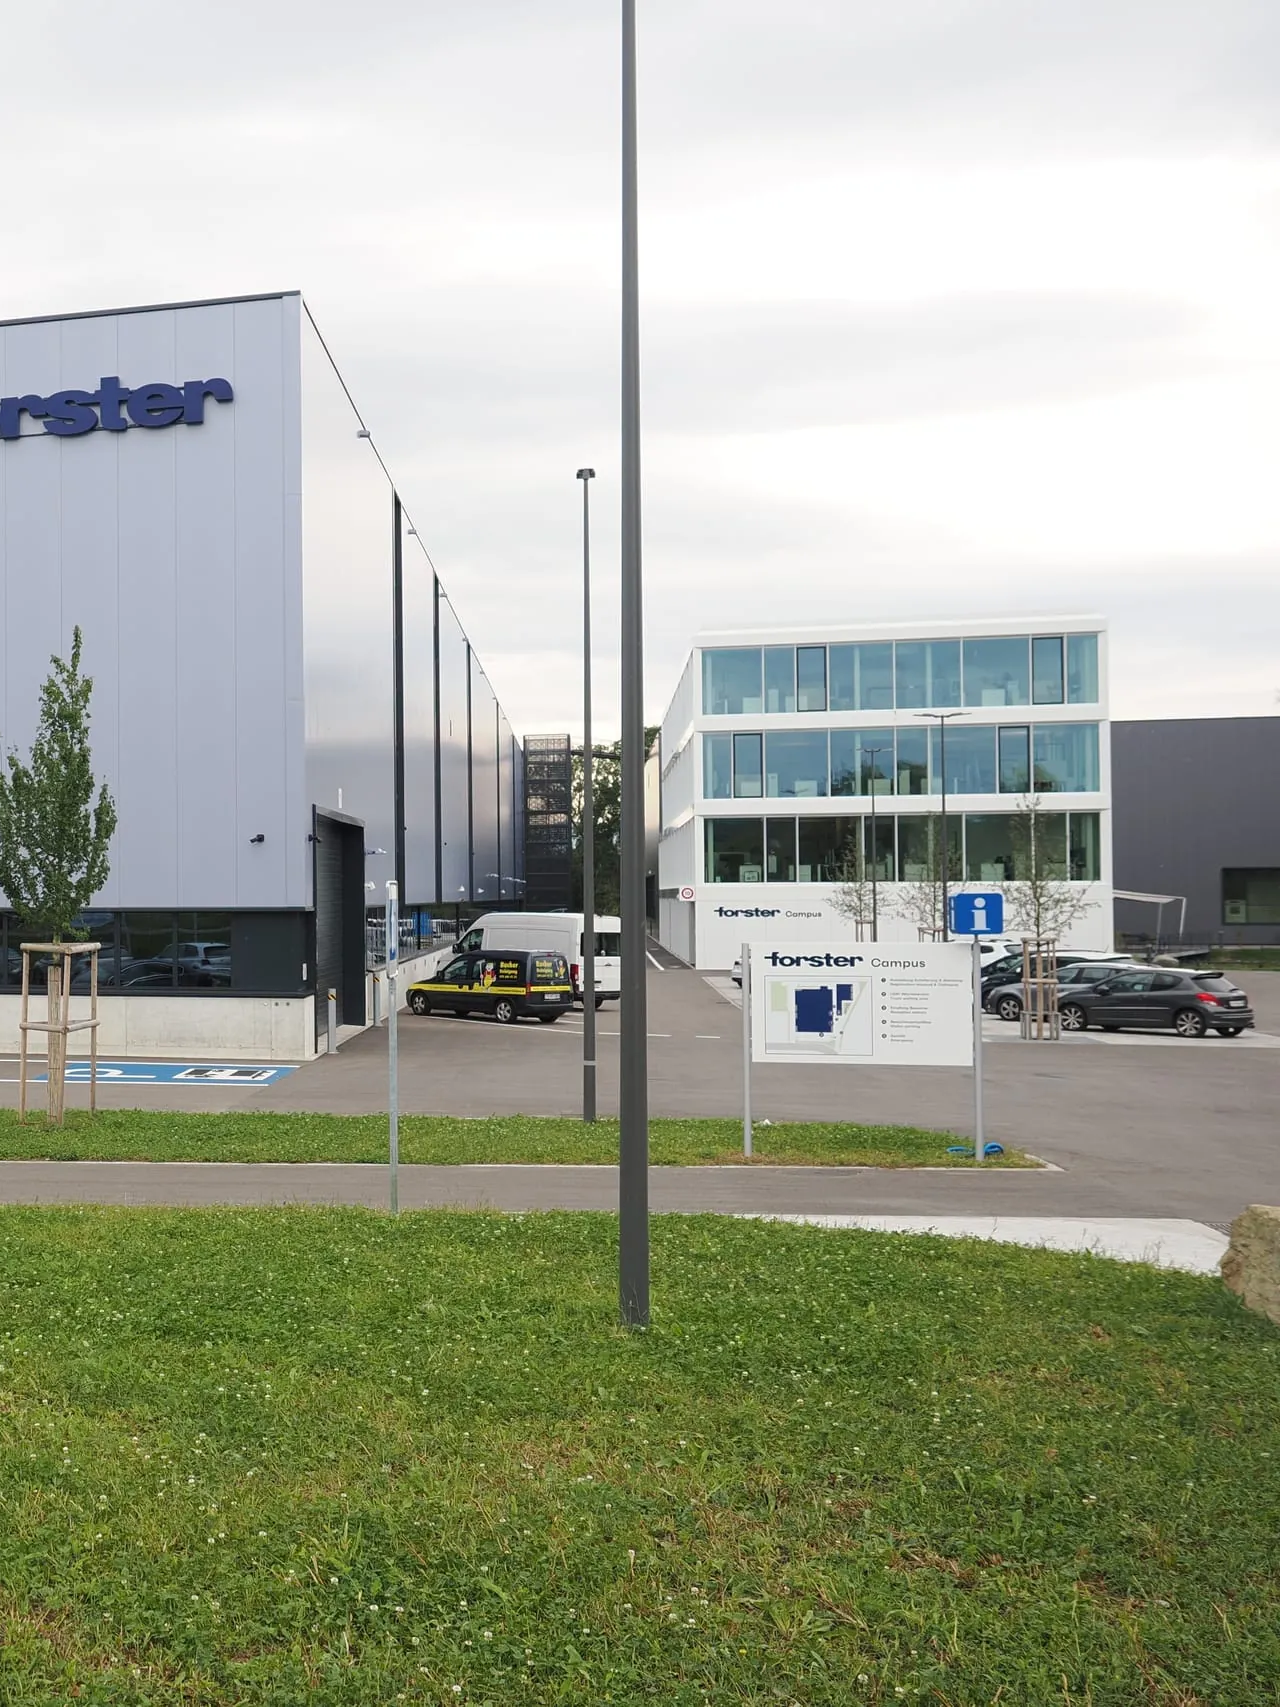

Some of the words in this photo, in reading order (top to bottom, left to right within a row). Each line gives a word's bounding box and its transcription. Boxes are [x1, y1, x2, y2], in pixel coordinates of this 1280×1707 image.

[714, 906, 781, 918] forster
[785, 910, 822, 918] Campus
[764, 951, 864, 967] forster
[871, 958, 926, 969] Campus
